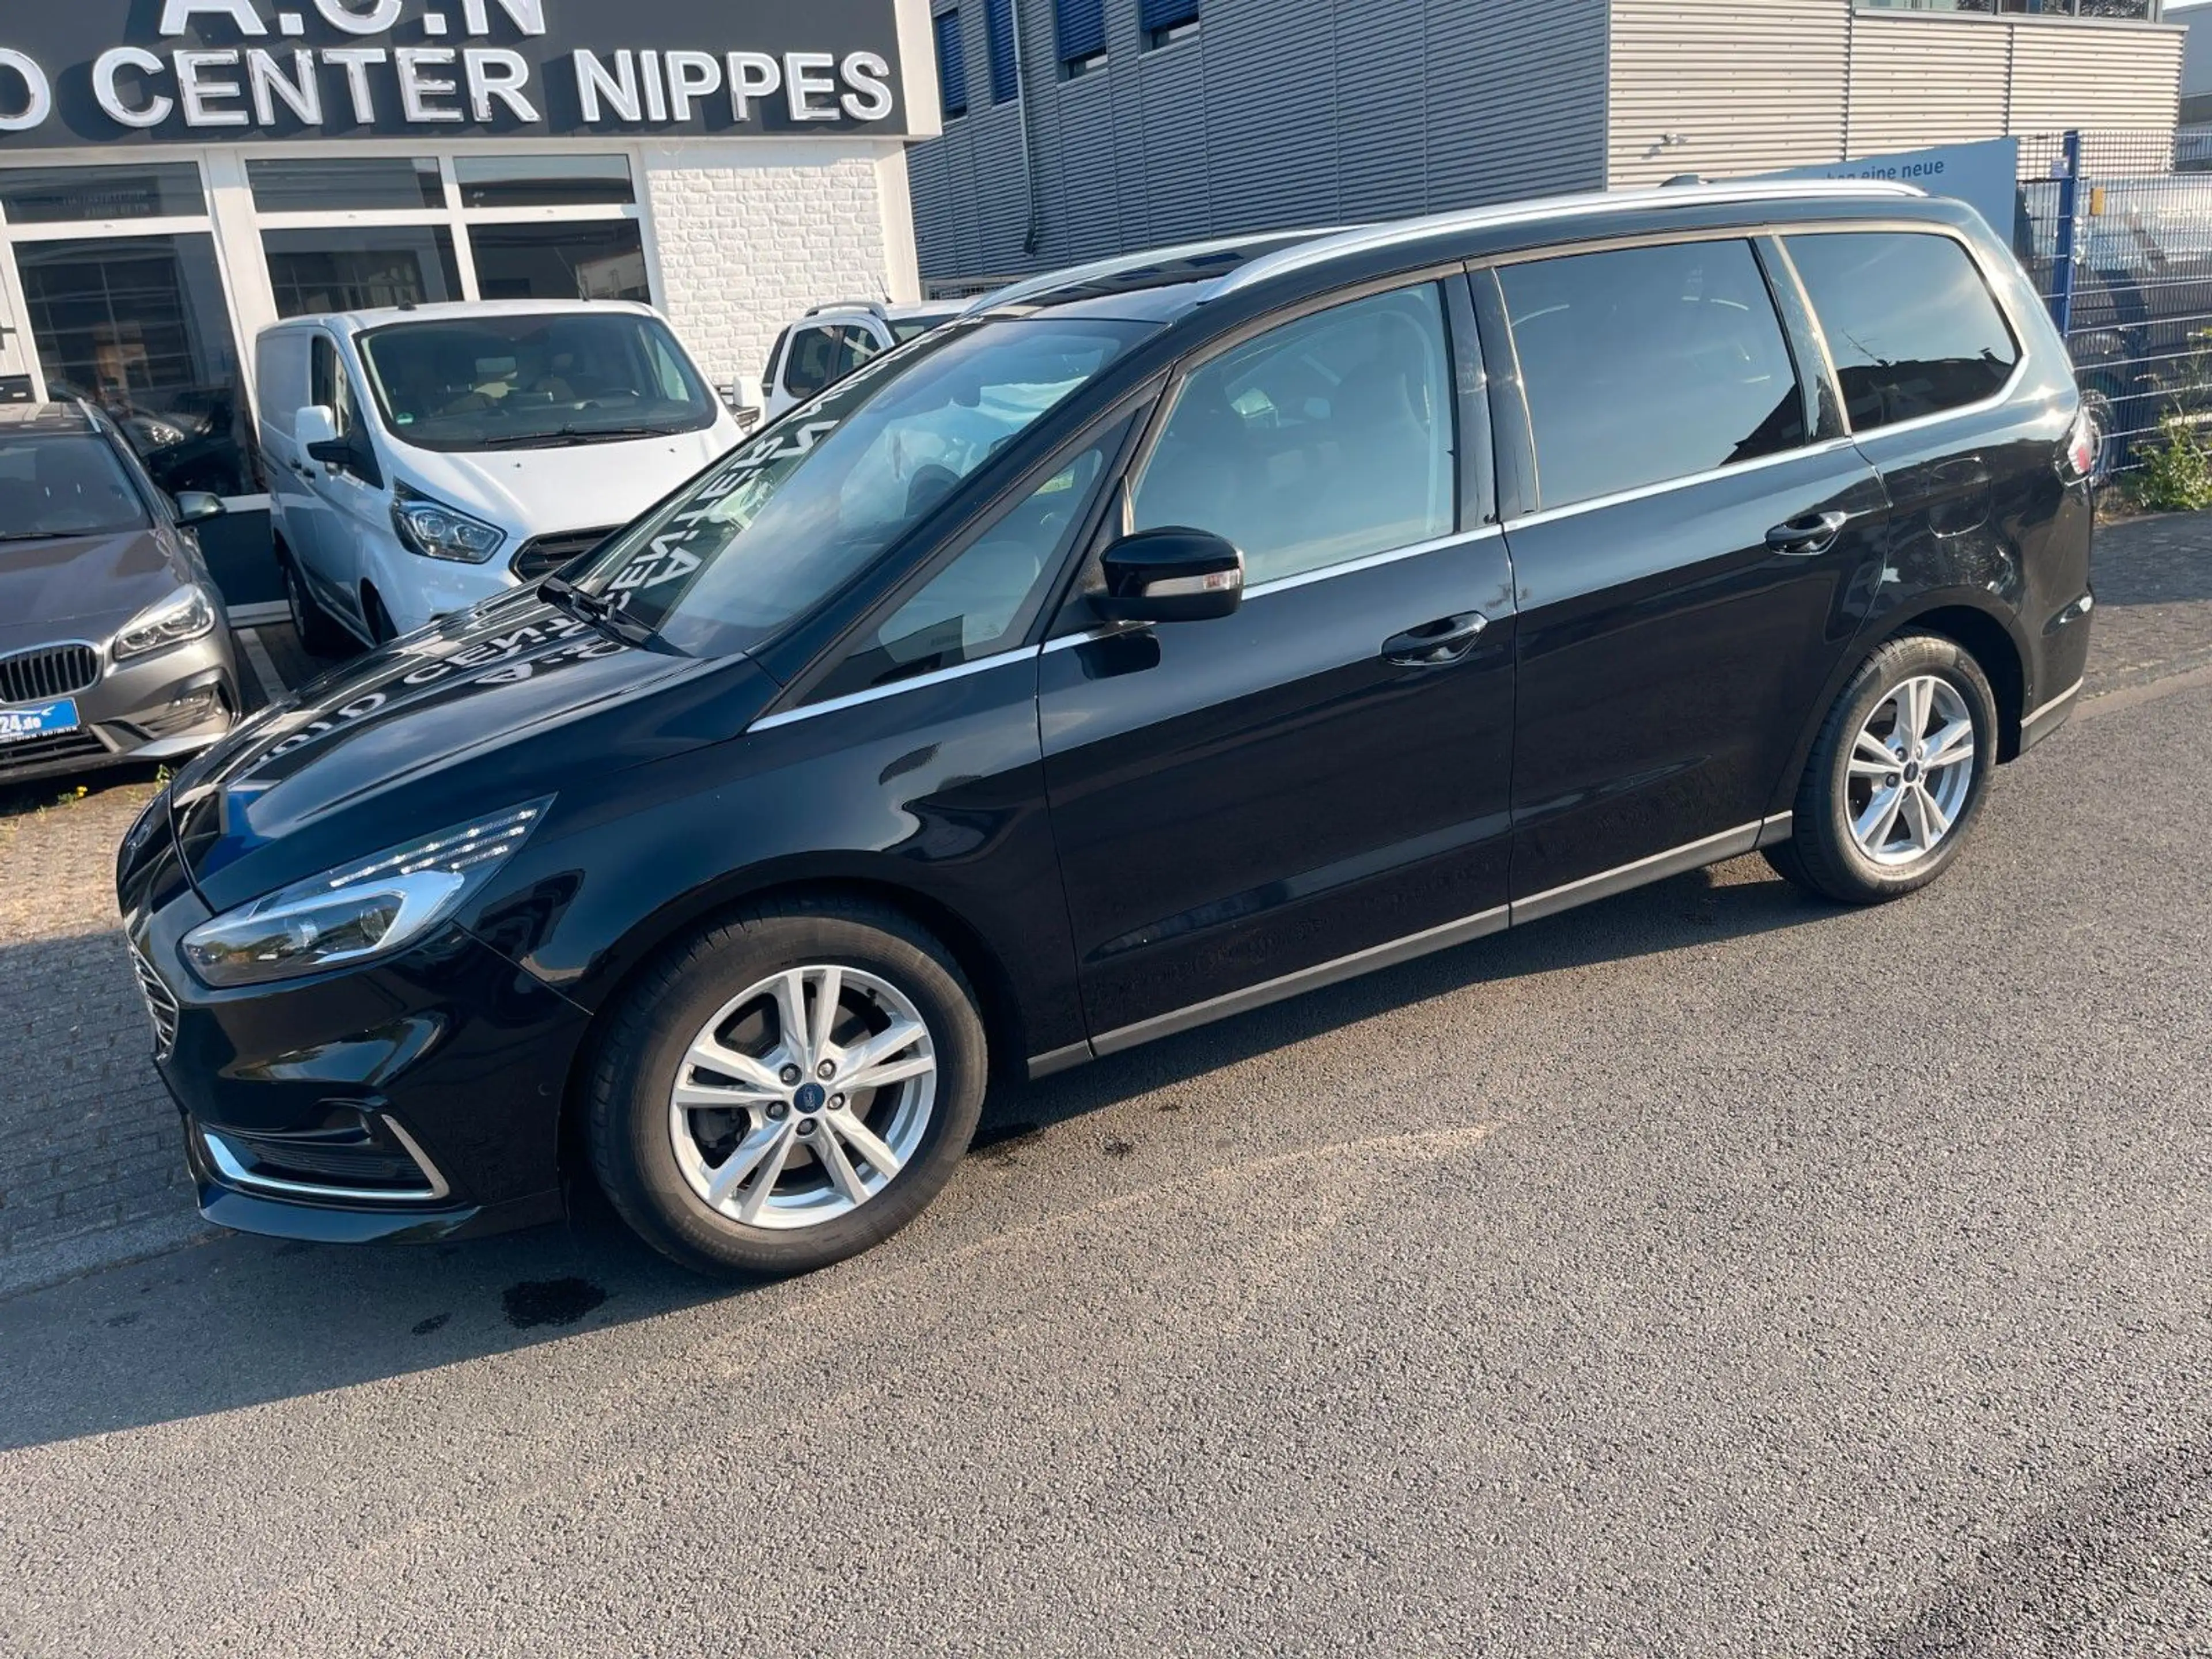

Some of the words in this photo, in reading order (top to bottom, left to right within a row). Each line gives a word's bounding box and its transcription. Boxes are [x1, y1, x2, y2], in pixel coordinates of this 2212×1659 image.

[92, 46, 542, 128] CENTER
[573, 48, 893, 123] NIPPES
[1861, 165, 1897, 180] eine
[1902, 160, 1944, 179] neue
